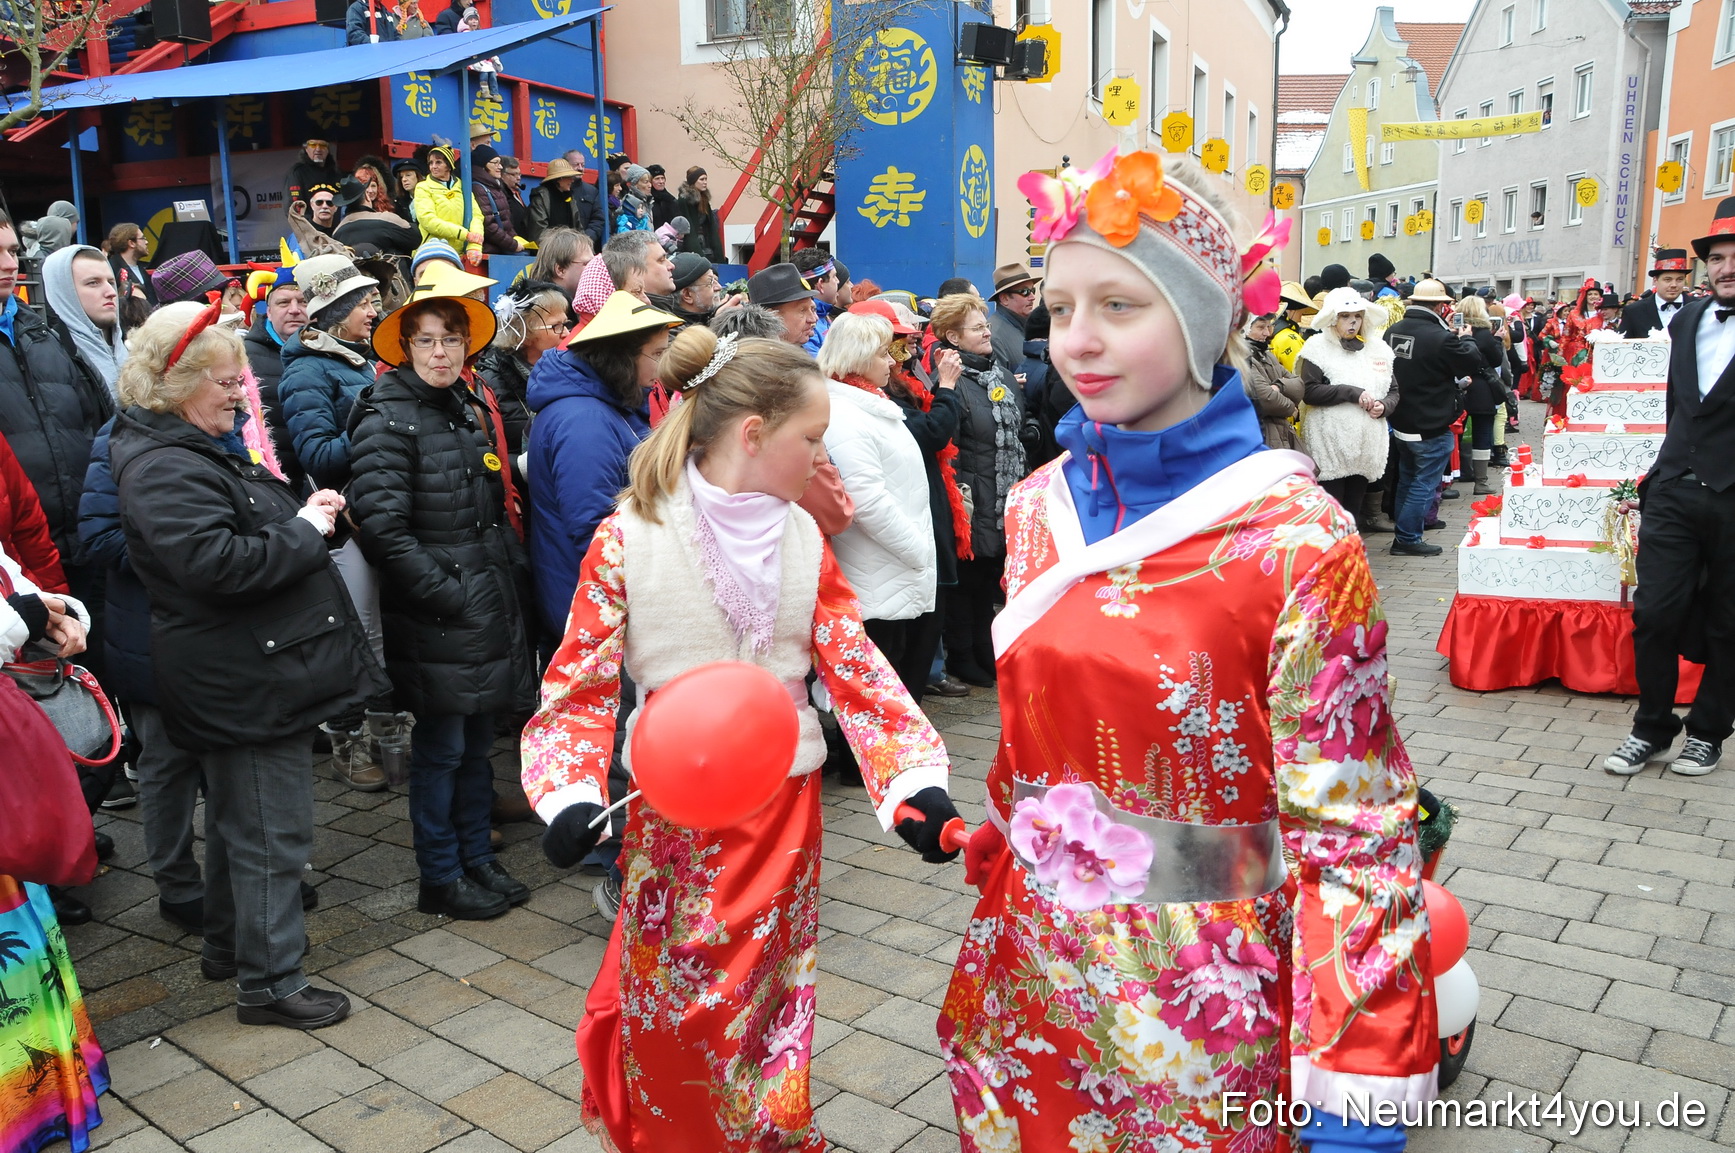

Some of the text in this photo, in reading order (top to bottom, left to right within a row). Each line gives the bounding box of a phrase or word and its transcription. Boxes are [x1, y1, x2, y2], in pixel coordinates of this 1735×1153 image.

[1614, 76, 1638, 246] UHREN SCHMUCK
[256, 192, 267, 203] DJ
[1471, 238, 1543, 267] OPTIK OEXL
